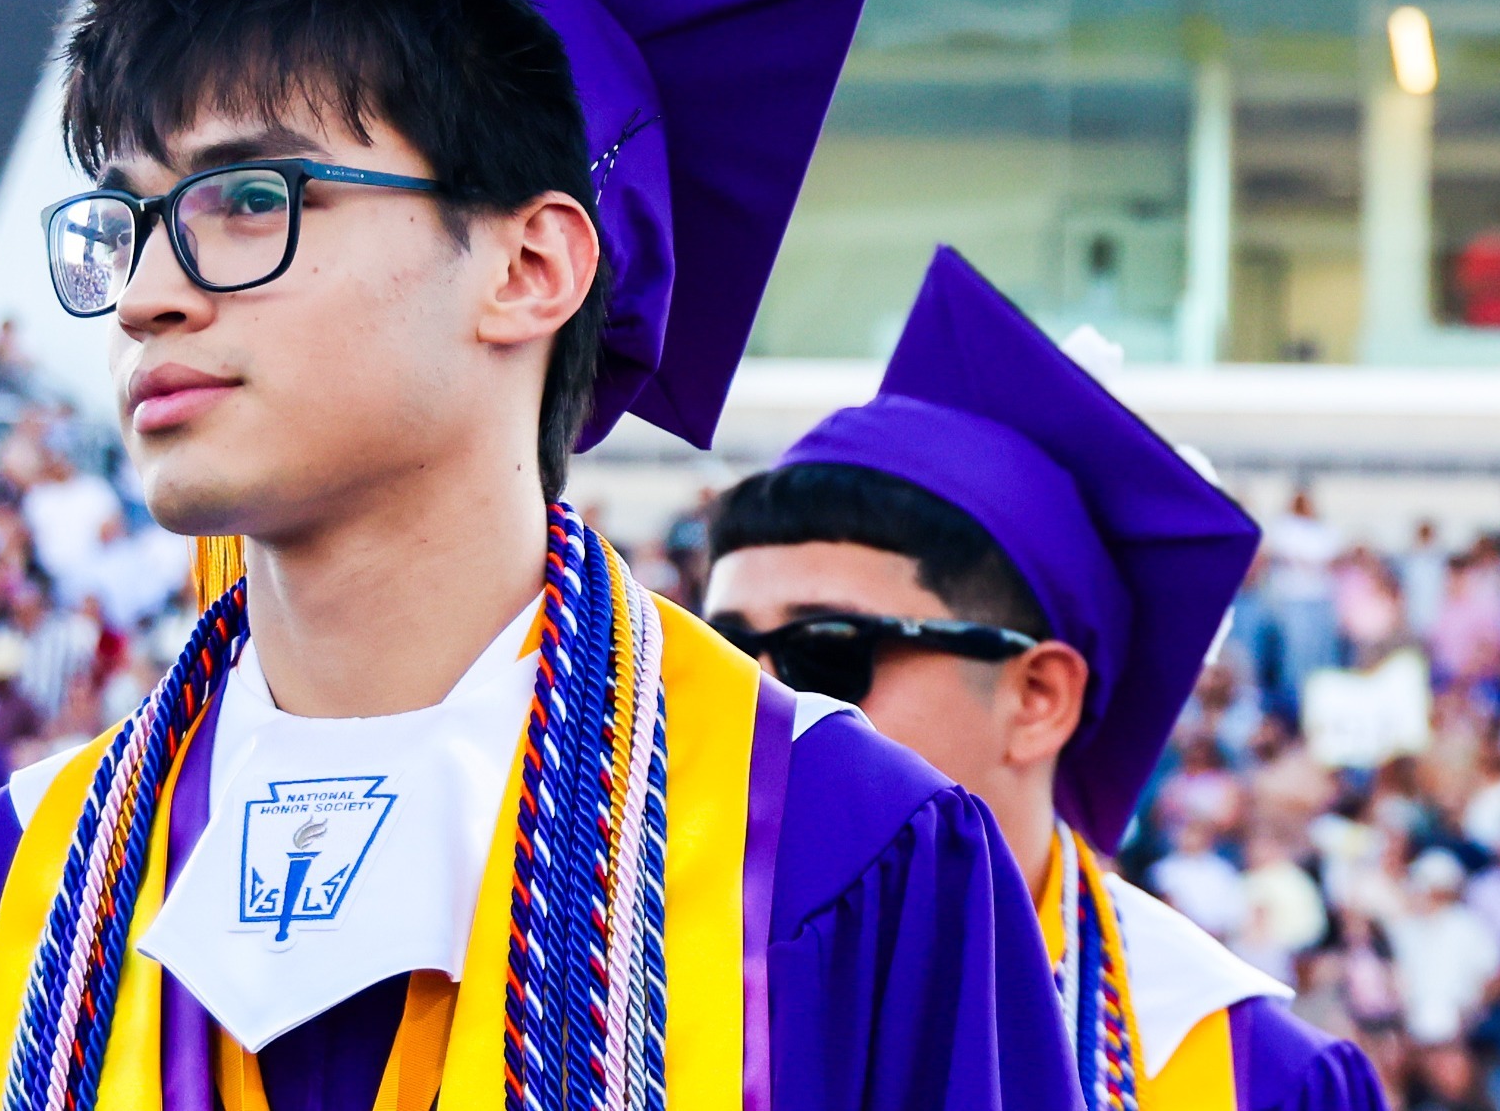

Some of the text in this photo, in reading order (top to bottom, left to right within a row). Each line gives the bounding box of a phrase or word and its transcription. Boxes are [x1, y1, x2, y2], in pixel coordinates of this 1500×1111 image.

[286, 791, 355, 803] NATIONAL
[260, 801, 375, 815] HONOR SOCIETY
